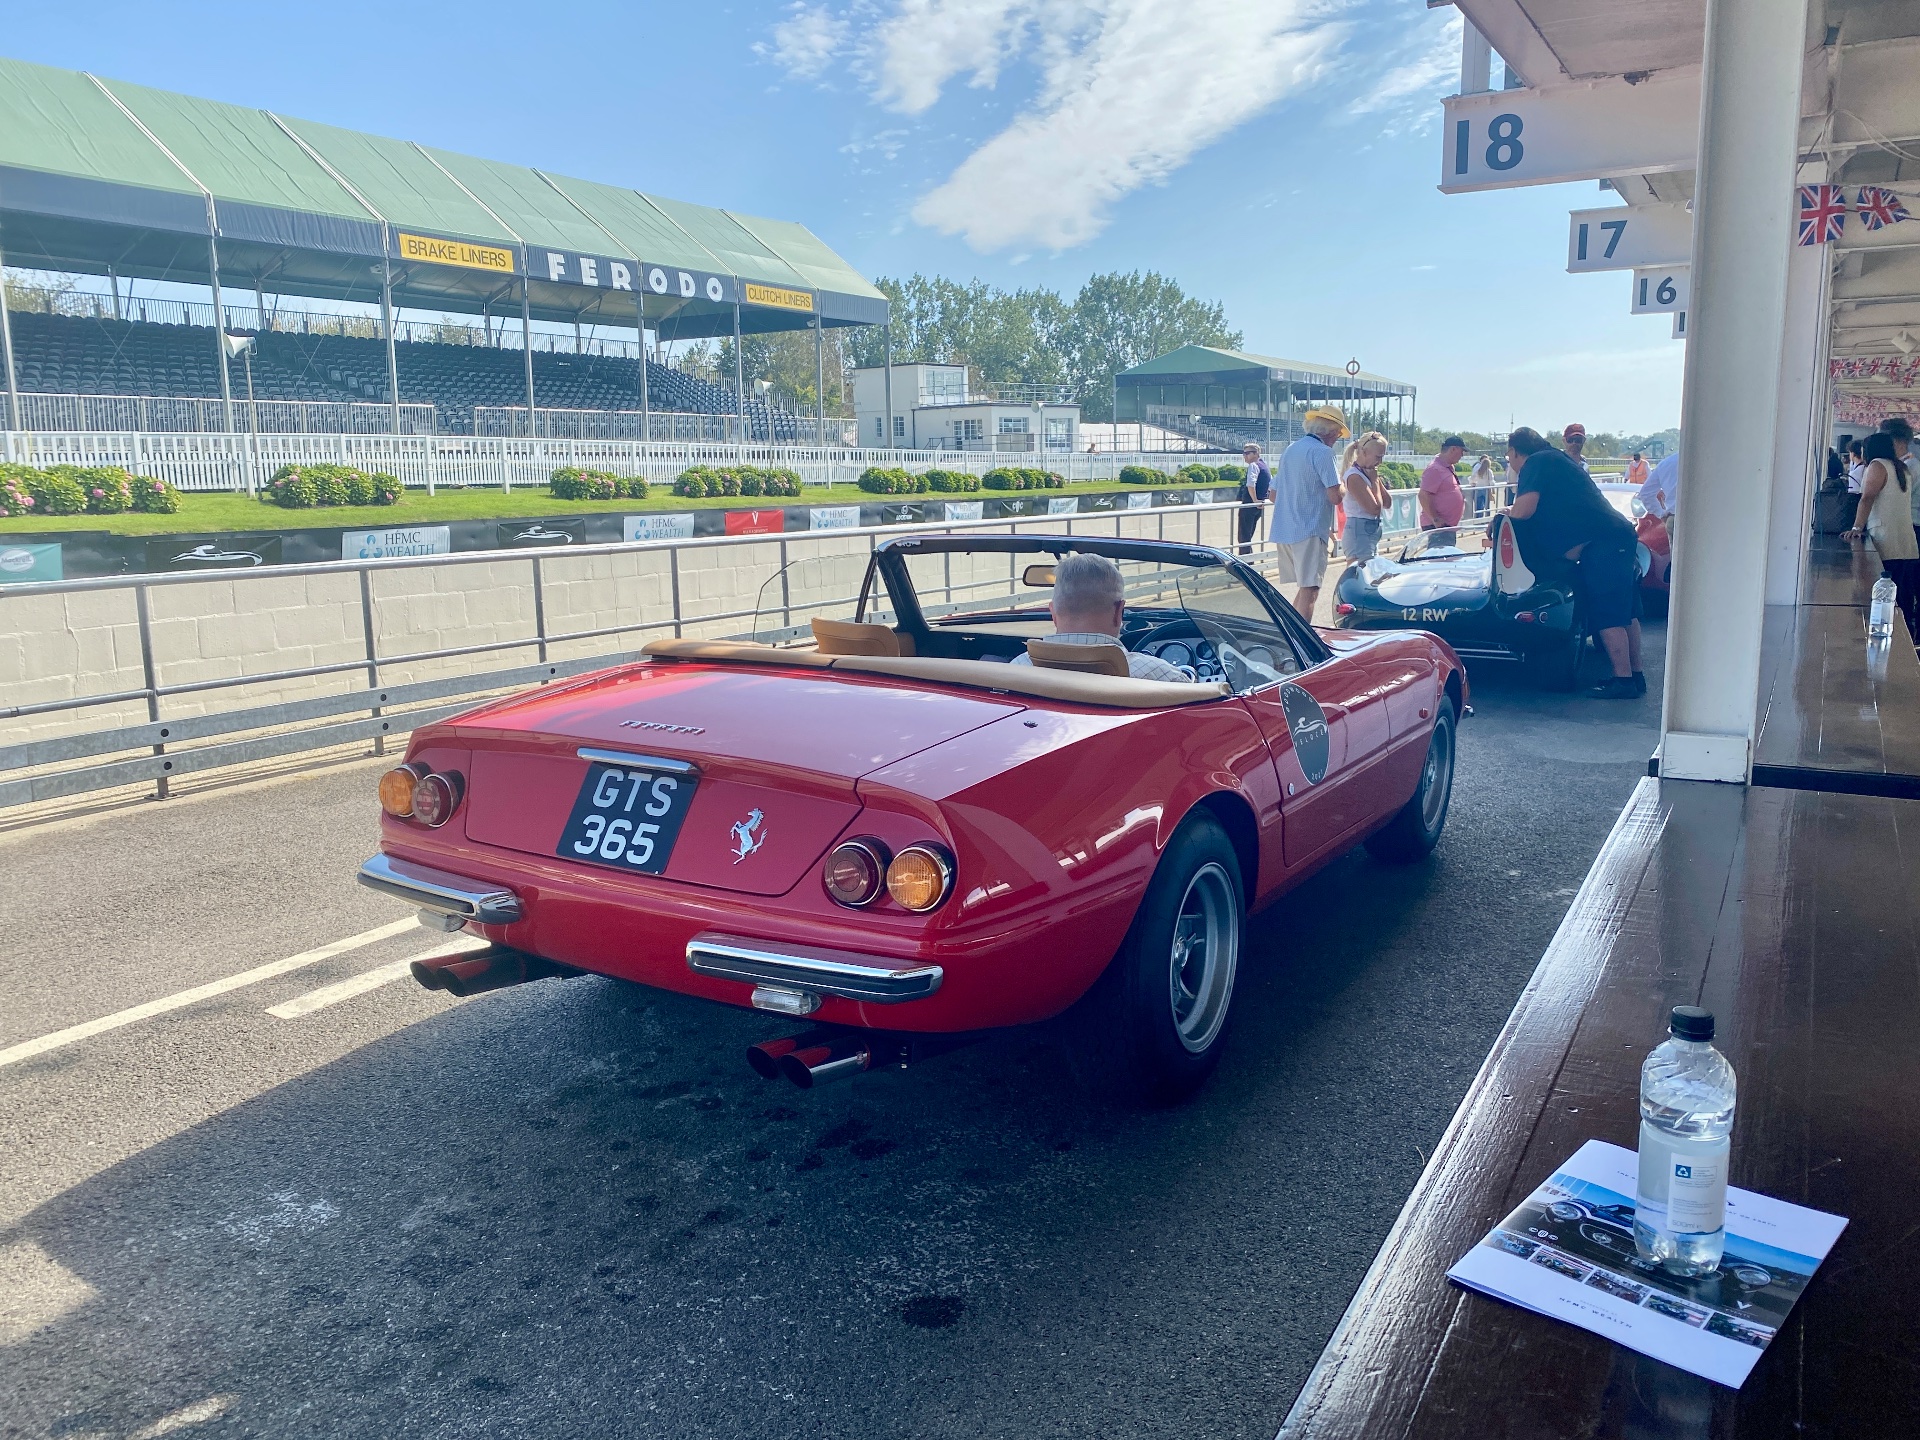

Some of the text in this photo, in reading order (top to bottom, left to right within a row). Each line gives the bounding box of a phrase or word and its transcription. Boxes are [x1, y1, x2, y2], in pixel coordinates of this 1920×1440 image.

[1455, 113, 1524, 175] 18
[1577, 219, 1628, 261] 17
[407, 239, 507, 267] BRAKE LINERS
[547, 251, 724, 303] FERODO
[748, 287, 811, 308] CLUTCH LINERS
[1639, 276, 1677, 306] 16
[1678, 311, 1686, 332] 1
[651, 517, 676, 529] HFMC
[651, 527, 684, 539] WEALTH
[384, 531, 421, 546] HFMC
[385, 543, 435, 557] WEALTH
[1401, 607, 1449, 622] 12 RW
[592, 768, 678, 817] GTS
[574, 814, 661, 865] 365
